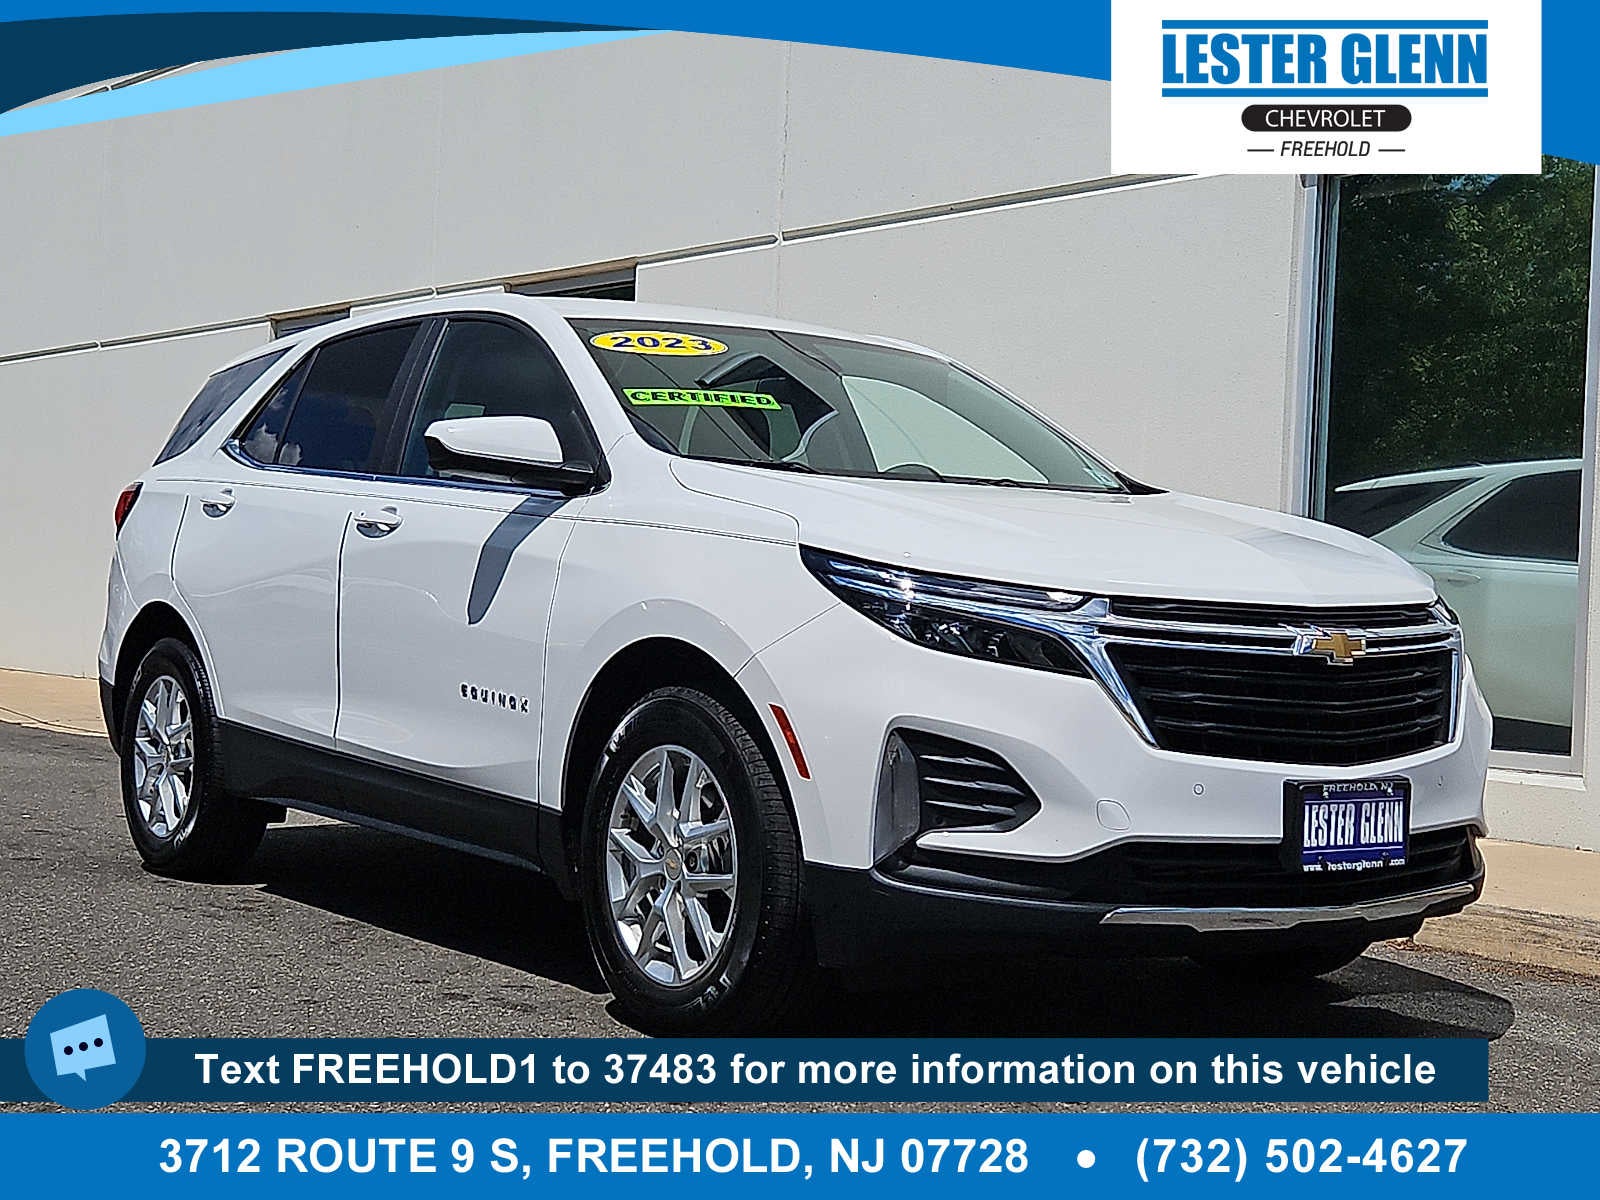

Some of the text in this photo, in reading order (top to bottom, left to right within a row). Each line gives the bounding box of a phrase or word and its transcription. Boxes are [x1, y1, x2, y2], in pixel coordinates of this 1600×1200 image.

[610, 335, 714, 351] 2023
[631, 391, 774, 406] CERTIFIED
[461, 683, 529, 713] EQUINOX
[1303, 801, 1403, 847] LESTER GLENN
